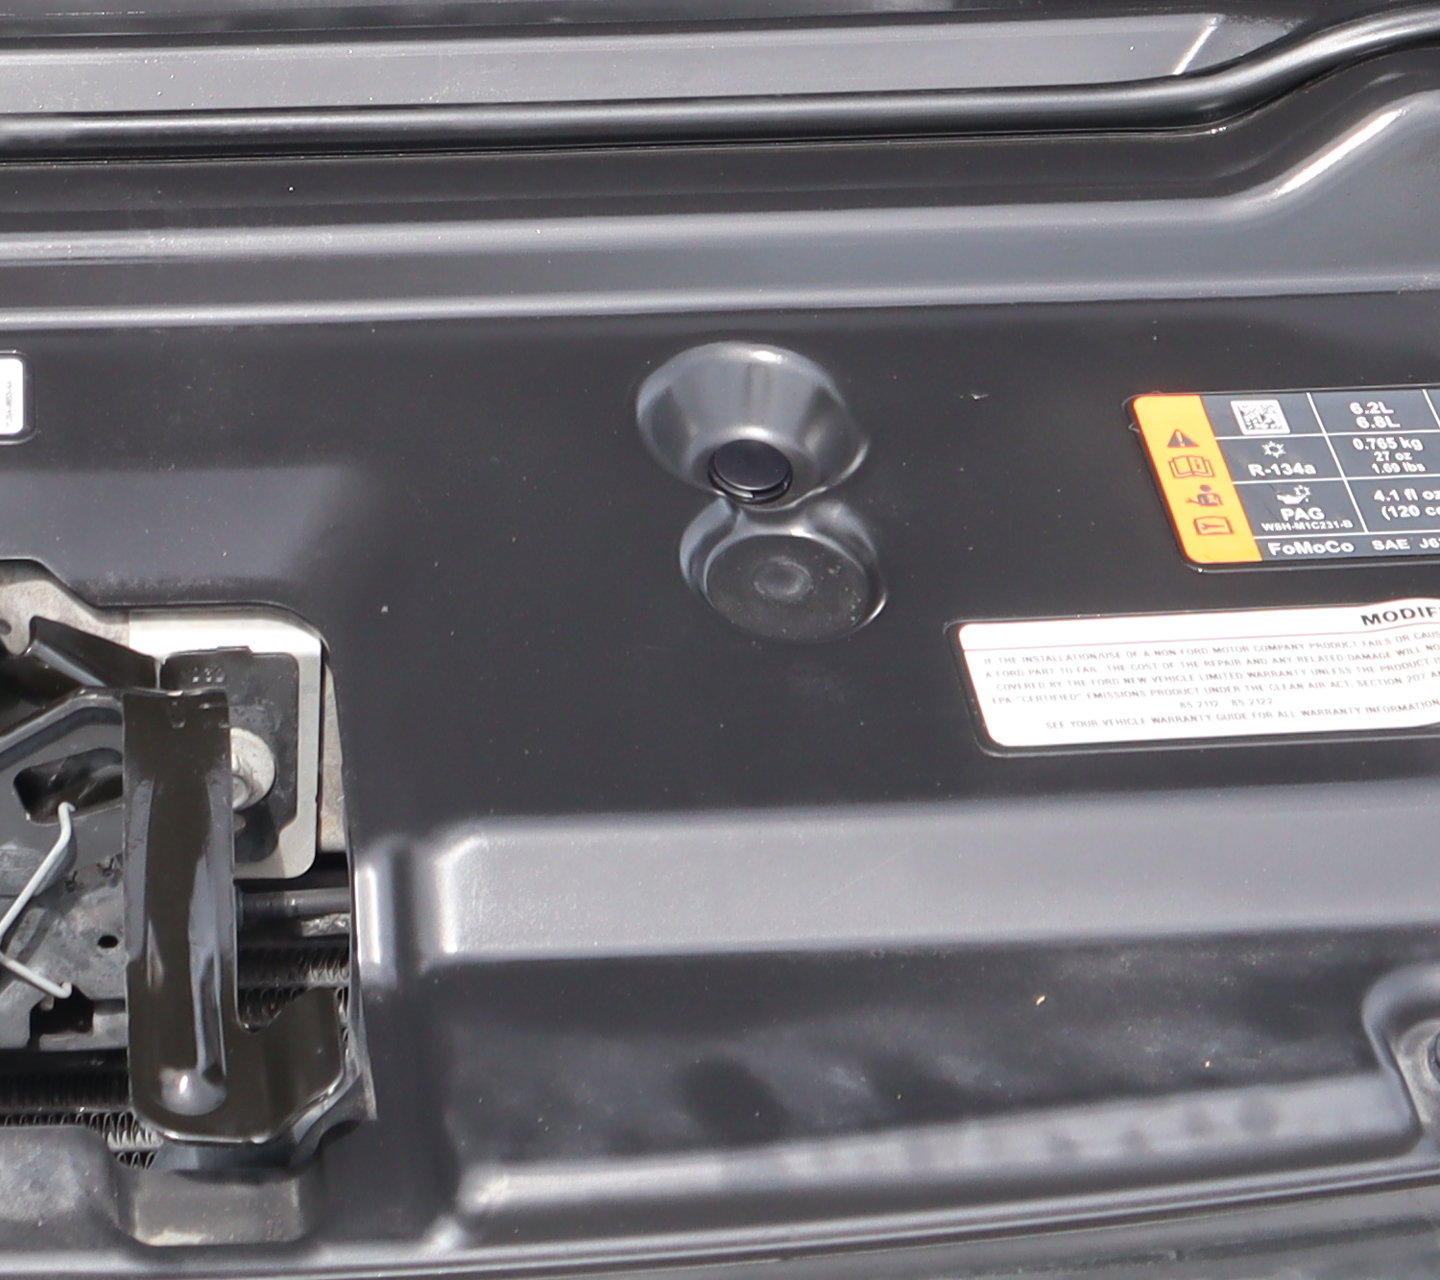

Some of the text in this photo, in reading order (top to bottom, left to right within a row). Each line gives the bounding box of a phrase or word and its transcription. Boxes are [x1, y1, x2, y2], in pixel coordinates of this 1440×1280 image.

[1349, 402, 1394, 415] 6.2L
[1356, 416, 1401, 429] 6.8L
[1352, 437, 1423, 451] 0.765 kg
[1374, 452, 1392, 462] 27
[1248, 462, 1316, 477] R-134a
[1372, 462, 1426, 474] 1.69 lbs
[1373, 490, 1400, 501] 4.1
[1403, 489, 1418, 501] fl
[1280, 508, 1325, 521] PAG
[1382, 505, 1420, 520] (120
[1268, 540, 1355, 556] FoMoCo
[1372, 538, 1410, 550] SAE
